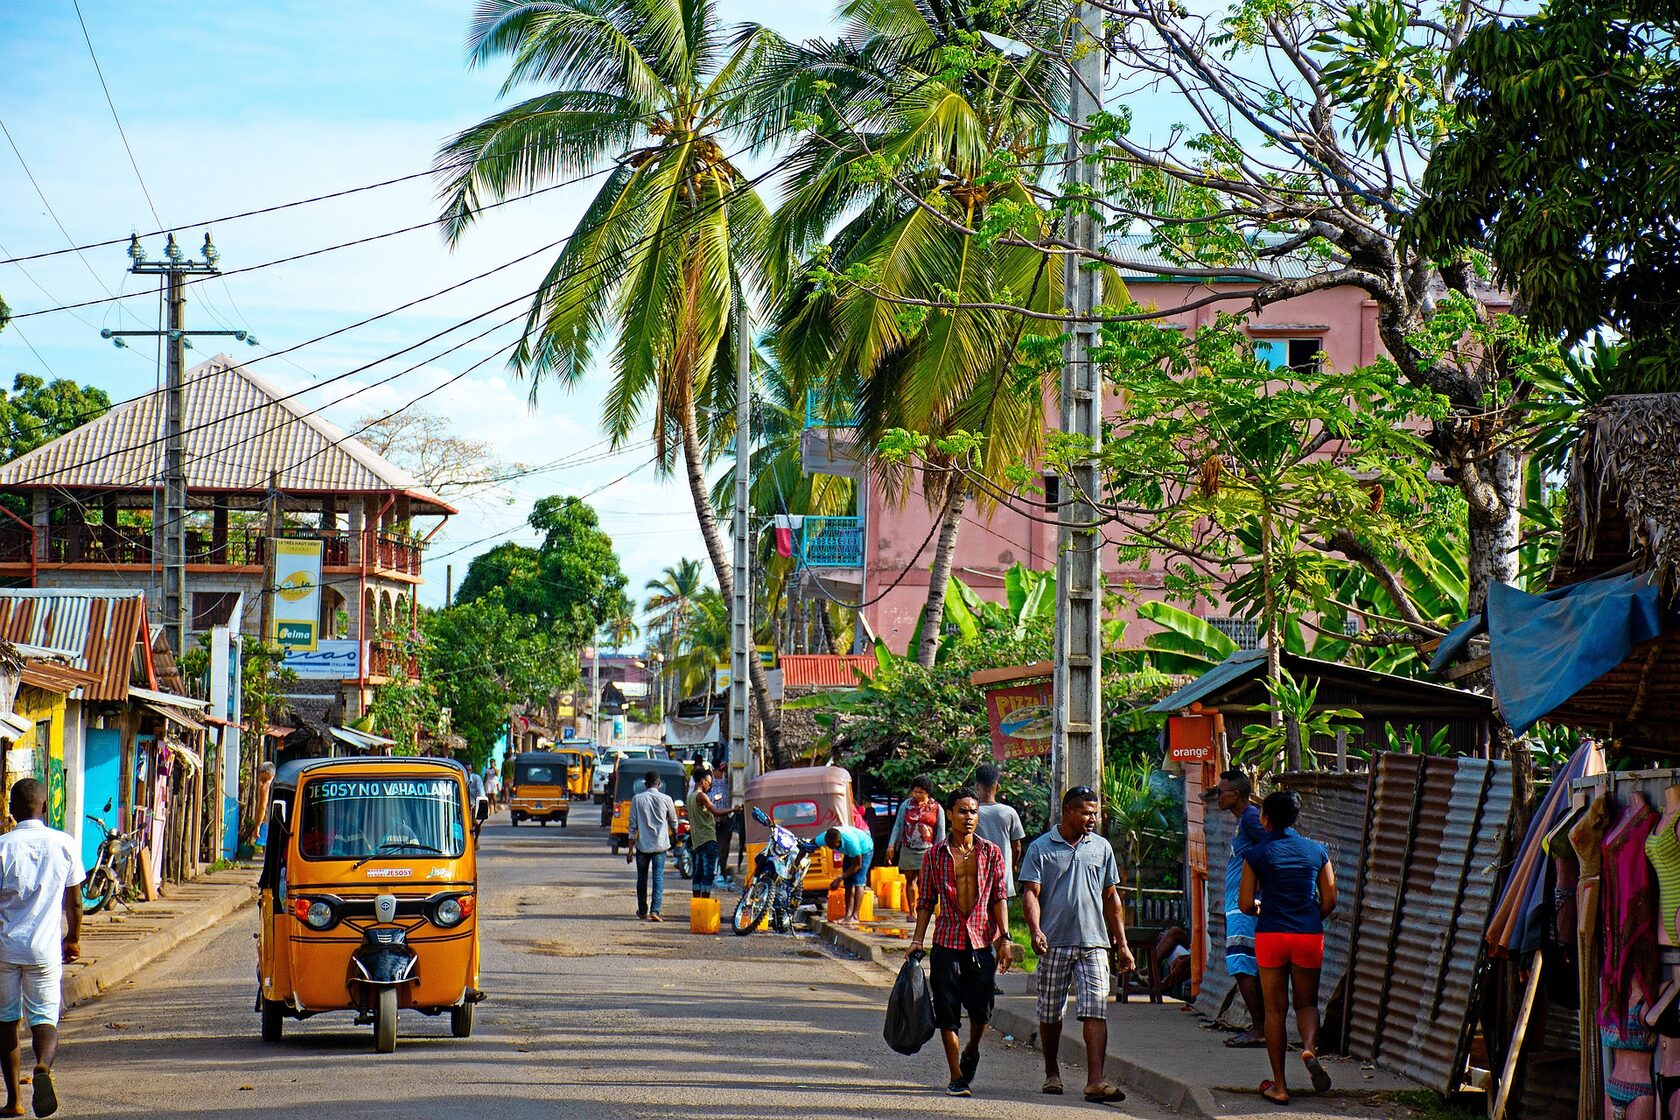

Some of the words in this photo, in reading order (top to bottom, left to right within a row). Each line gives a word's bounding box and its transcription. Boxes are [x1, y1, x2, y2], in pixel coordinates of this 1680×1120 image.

[1173, 748, 1209, 758] orange
[309, 783, 355, 799] JESOSY
[359, 783, 380, 796] NO
